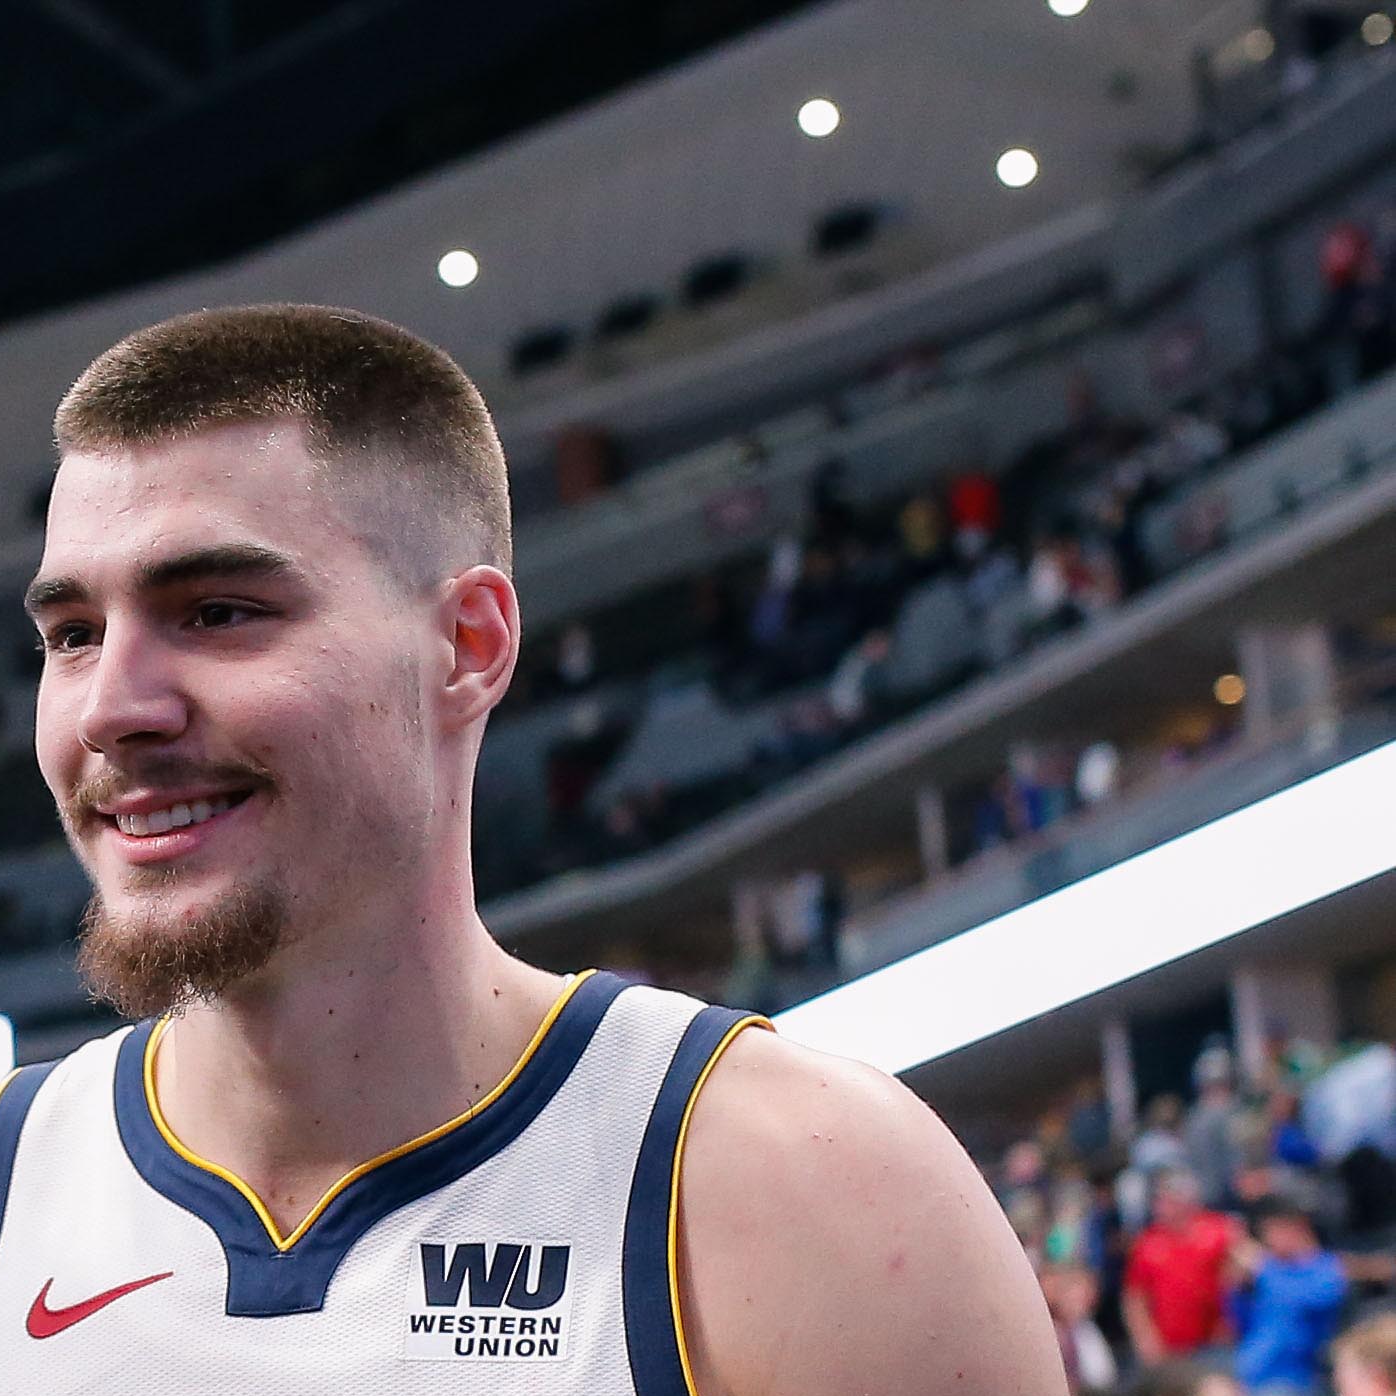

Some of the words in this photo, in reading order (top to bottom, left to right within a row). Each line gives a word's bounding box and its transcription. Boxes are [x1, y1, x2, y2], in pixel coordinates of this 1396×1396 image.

[420, 1243, 570, 1310] WU
[410, 1314, 562, 1335] WESTERN
[454, 1337, 559, 1357] UNION
